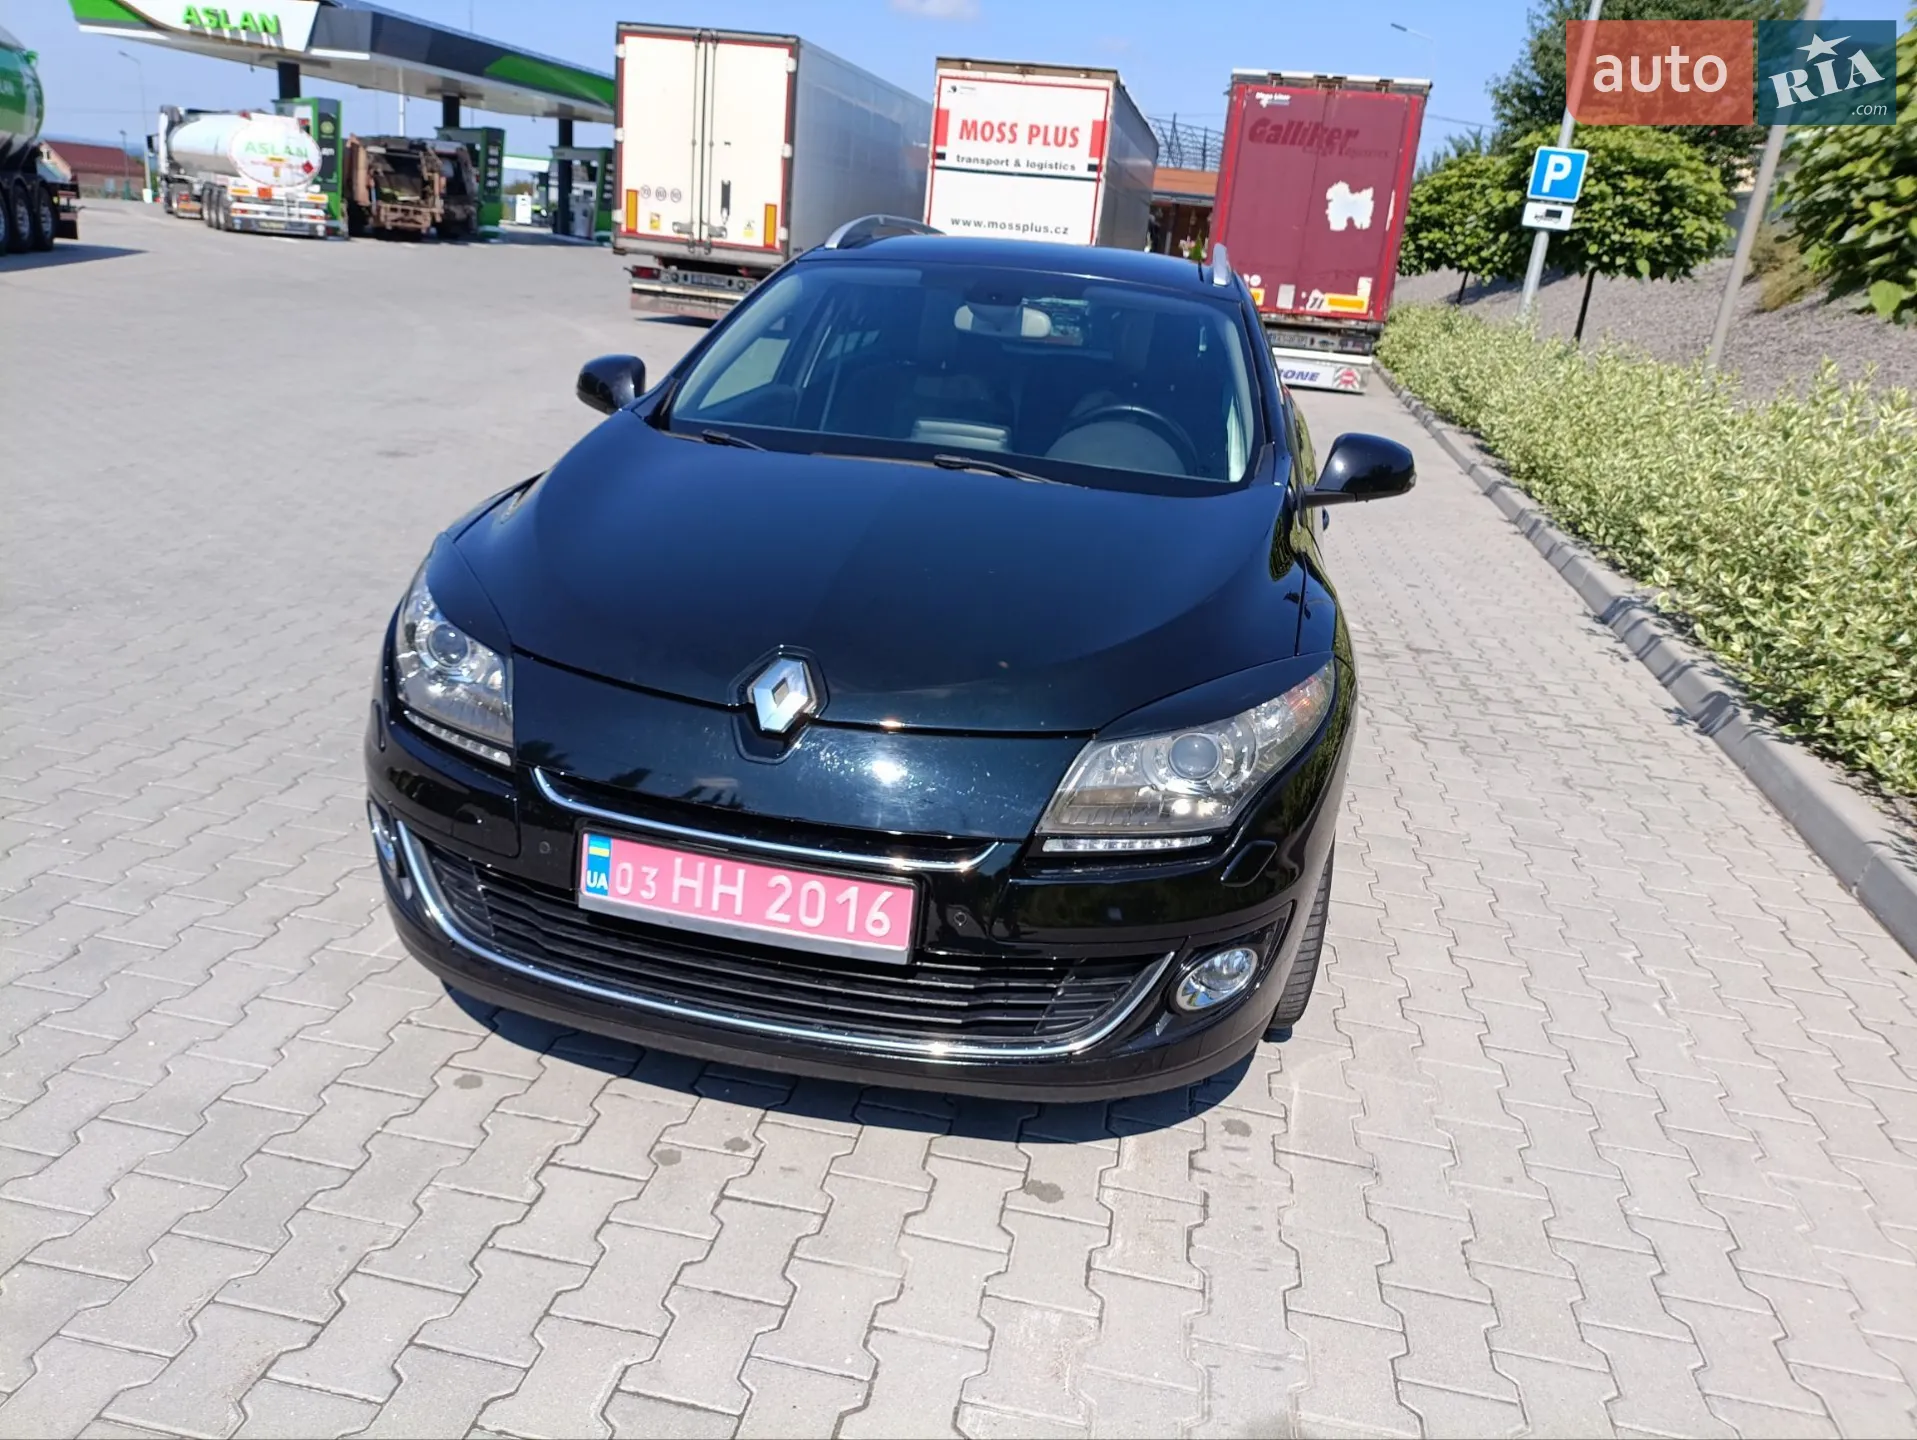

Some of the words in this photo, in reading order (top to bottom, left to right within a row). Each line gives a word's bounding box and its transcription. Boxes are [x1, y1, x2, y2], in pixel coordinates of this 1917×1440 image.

[183, 5, 280, 34] ASLAN
[959, 119, 1018, 144] MOSS
[1027, 124, 1080, 148] PLUS
[1248, 116, 1360, 149] Galliker
[245, 142, 309, 158] ASLAN
[956, 154, 1009, 166] transport
[1013, 158, 1021, 167] &
[1026, 160, 1076, 171] logistics
[1541, 154, 1572, 193] P
[950, 217, 1069, 235] www.mossplus.cz
[586, 870, 609, 890] UA
[615, 862, 659, 900] 03
[671, 857, 746, 916] HH
[764, 874, 894, 937] 2016
